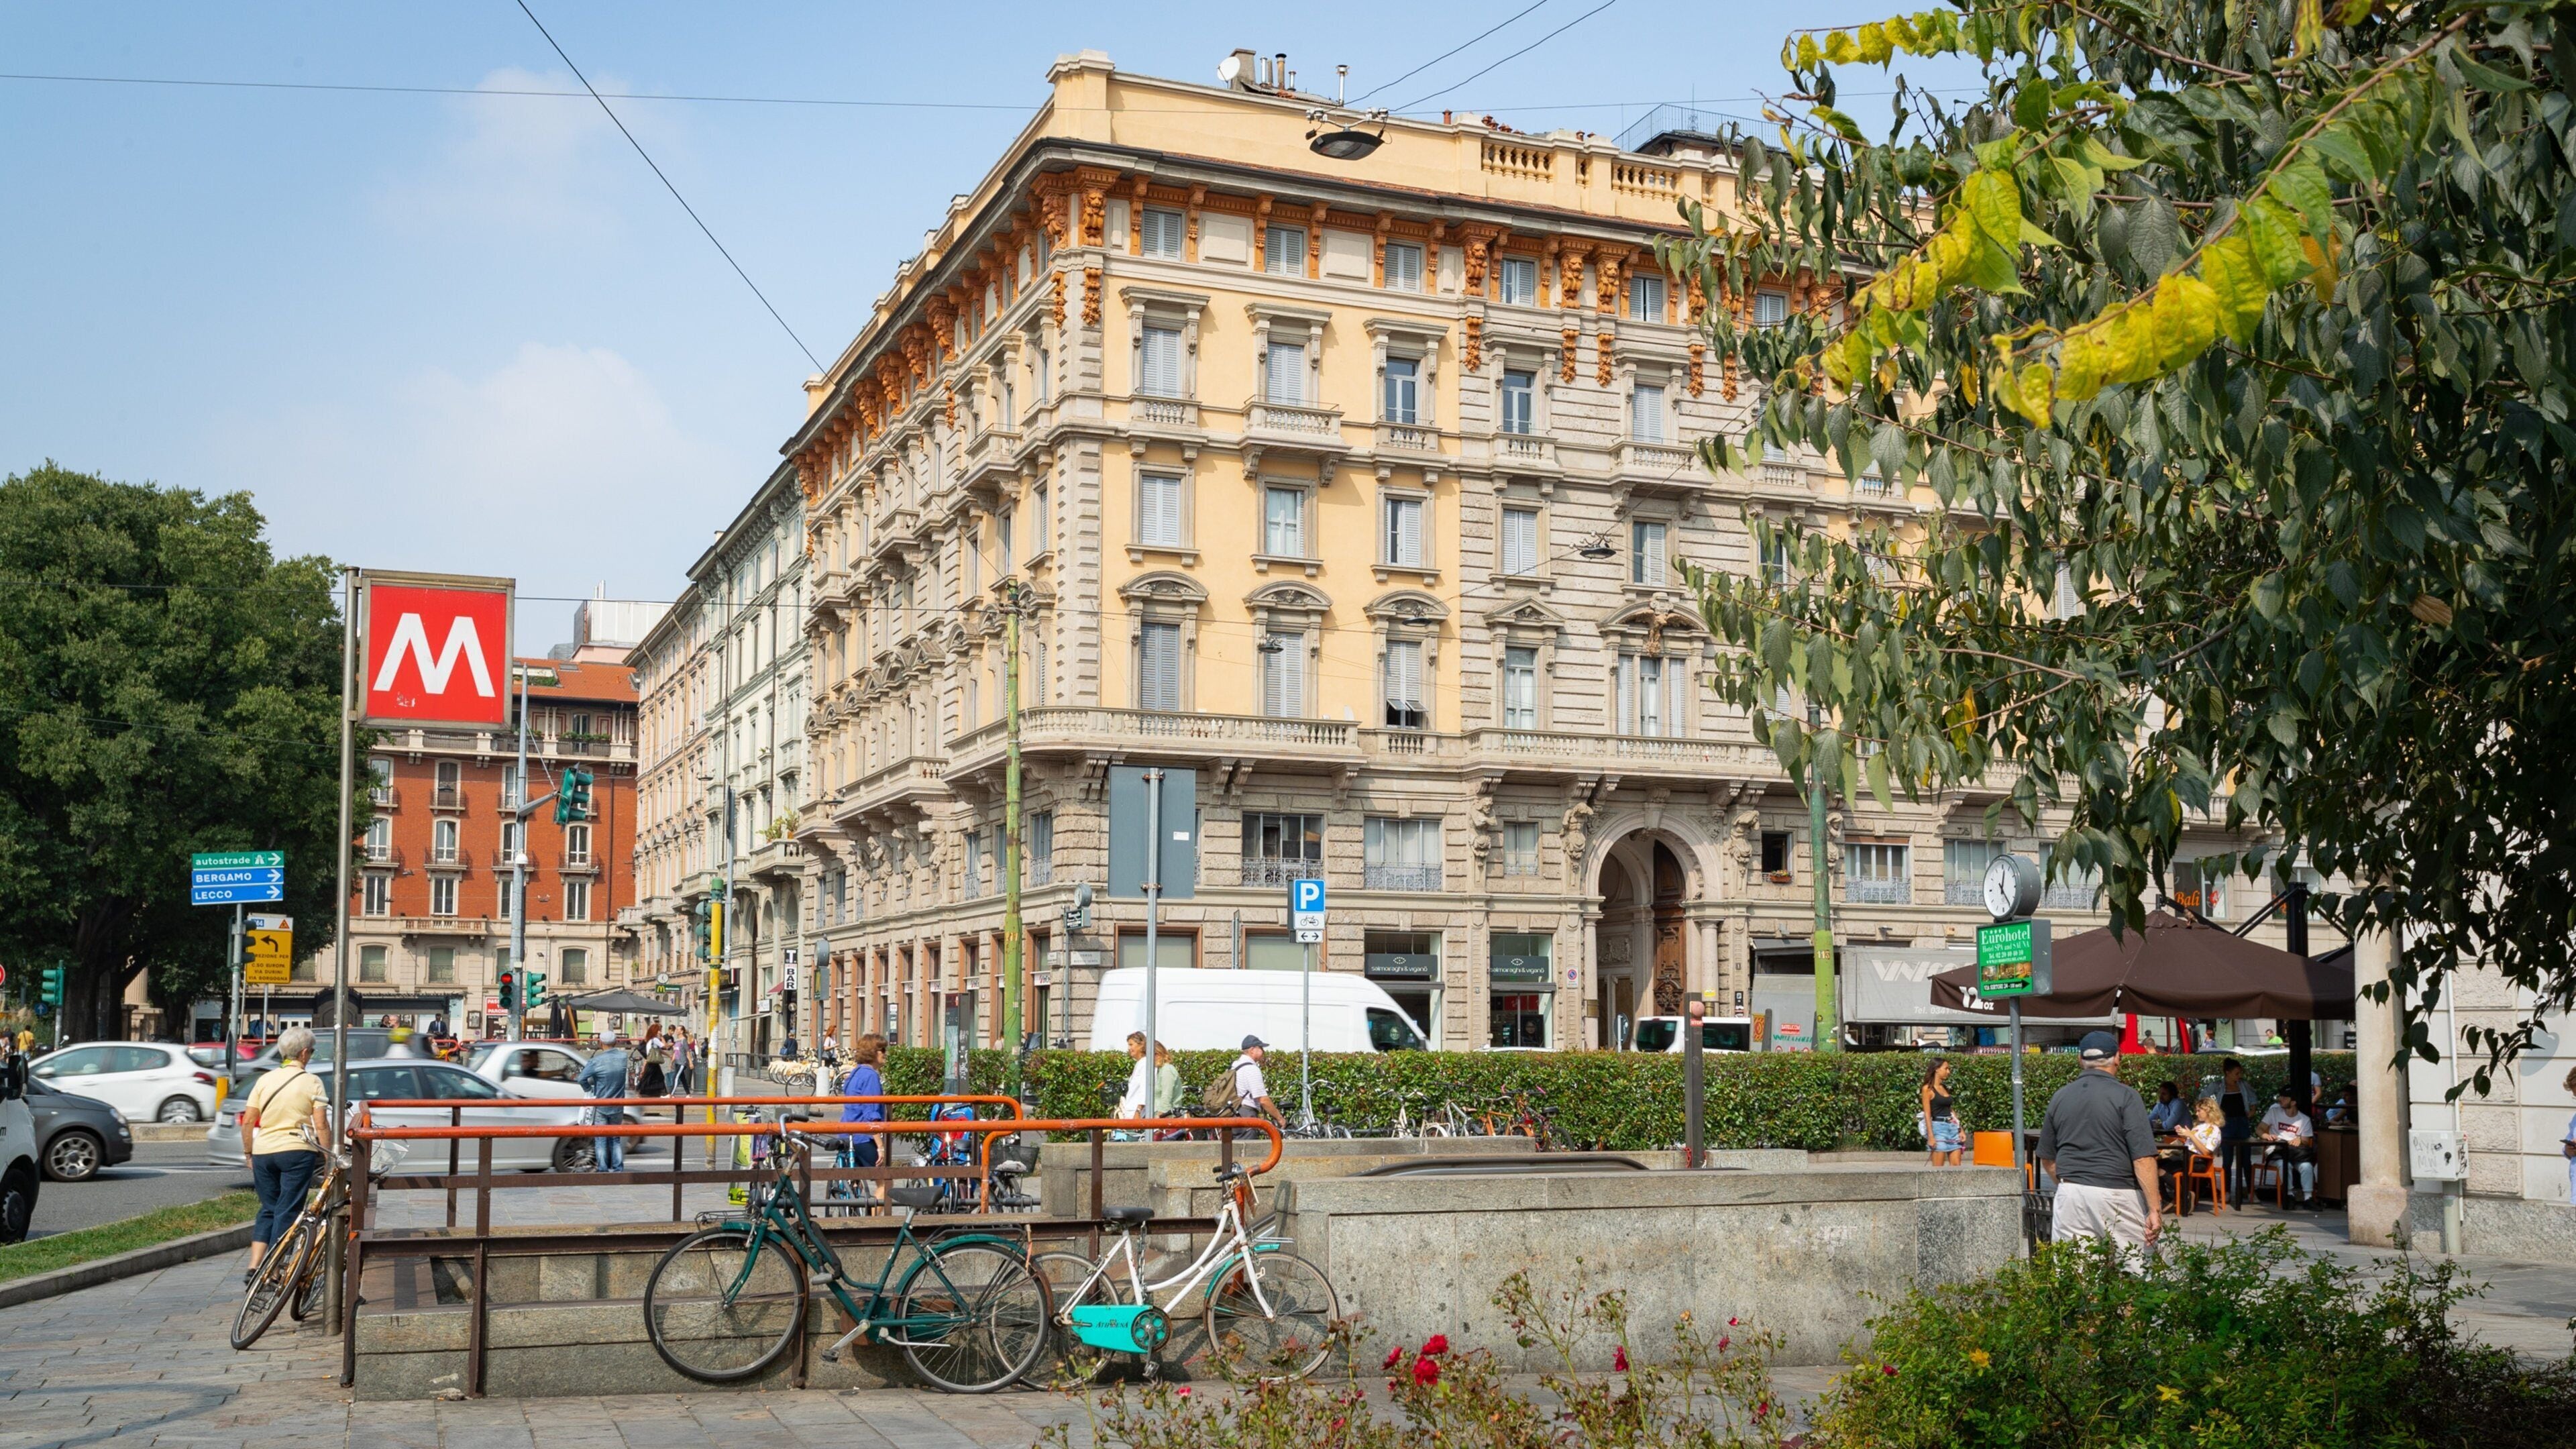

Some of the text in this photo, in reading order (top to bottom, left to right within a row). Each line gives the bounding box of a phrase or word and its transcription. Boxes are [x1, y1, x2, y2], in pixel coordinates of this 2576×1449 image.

[372, 612, 496, 698] M
[195, 857, 251, 866] autostrade
[195, 872, 252, 883] BERGAMO
[195, 890, 233, 900] LECCO
[1300, 882, 1320, 910] P
[2176, 890, 2200, 906] Bali
[786, 969, 795, 989] BAR
